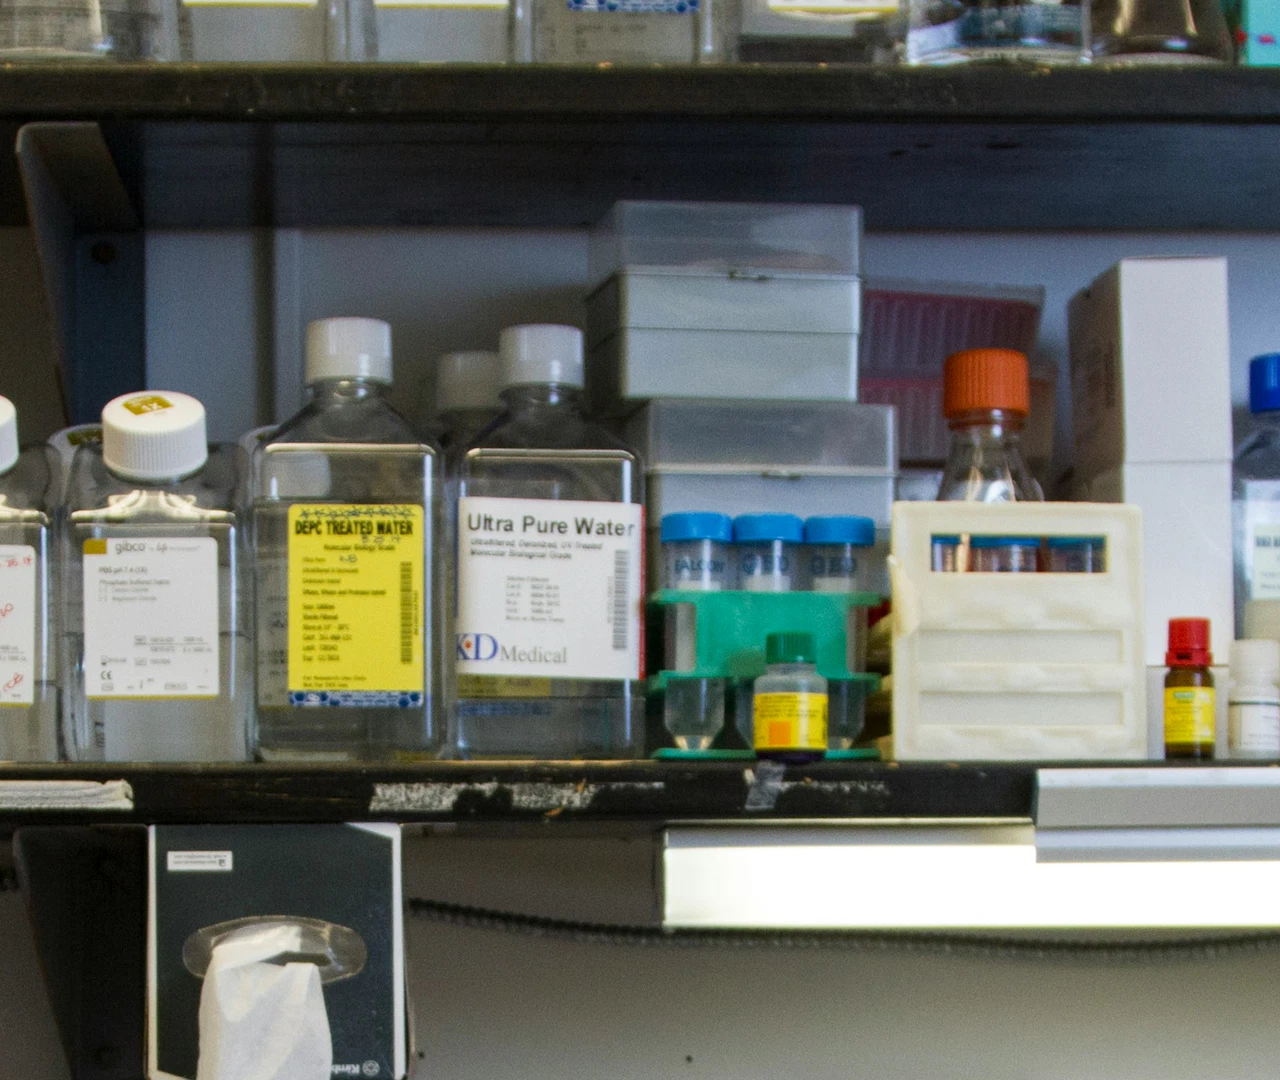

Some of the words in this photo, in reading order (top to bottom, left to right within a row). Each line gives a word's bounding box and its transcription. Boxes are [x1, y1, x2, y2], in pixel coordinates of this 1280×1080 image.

[295, 520, 322, 535] DEPC
[326, 520, 374, 535] TREATED
[377, 520, 413, 535] WATER
[468, 513, 514, 532] Ultra
[522, 515, 568, 534] Pure
[574, 517, 635, 536] Water
[115, 540, 146, 555] gibco
[500, 645, 567, 664] Medical
